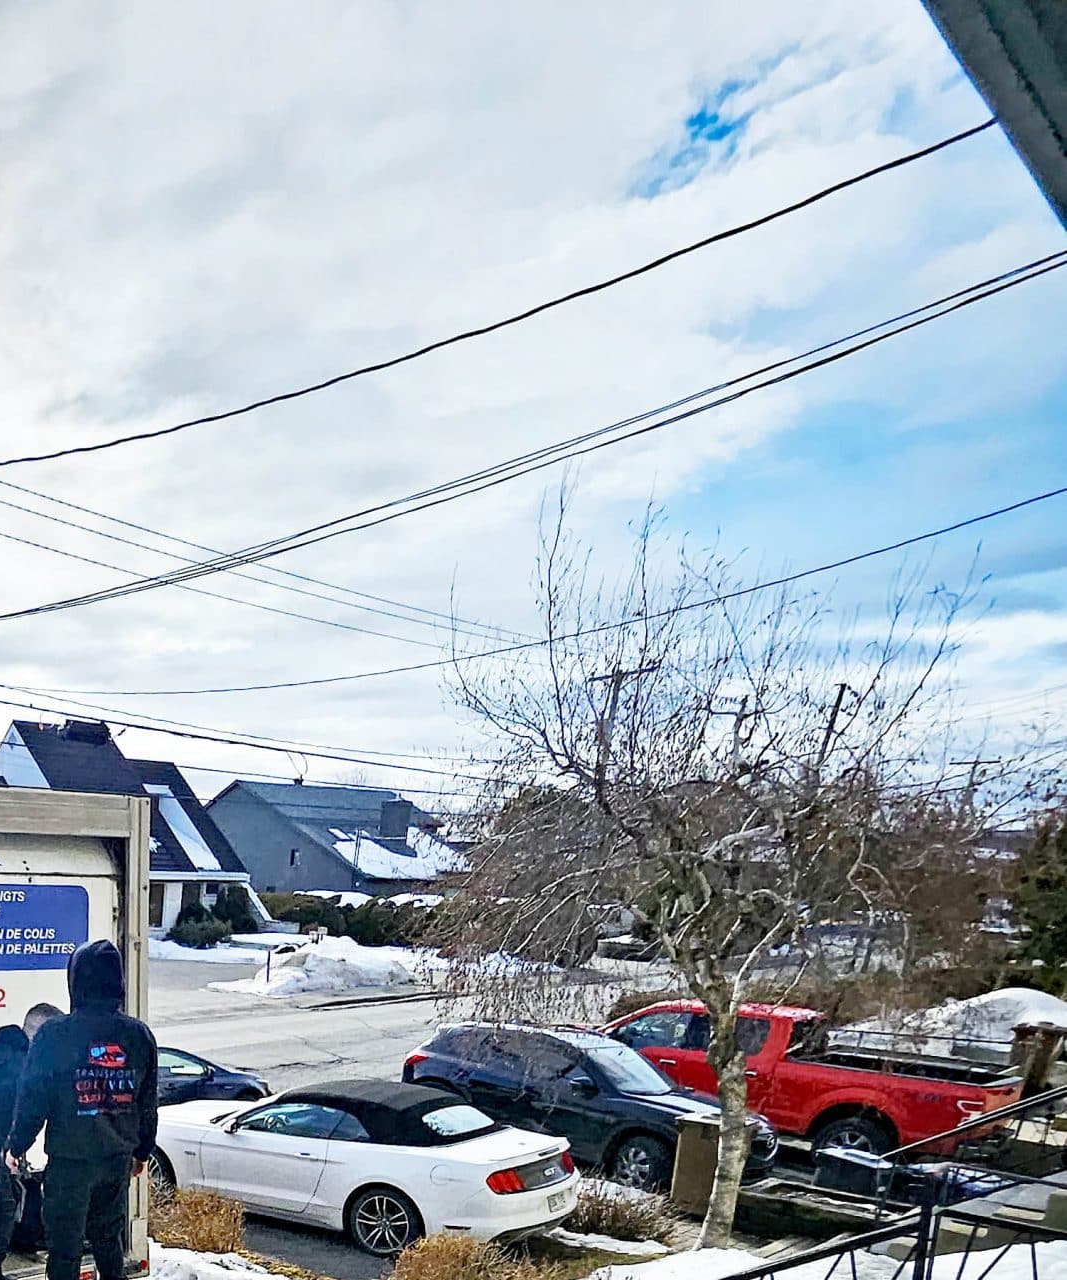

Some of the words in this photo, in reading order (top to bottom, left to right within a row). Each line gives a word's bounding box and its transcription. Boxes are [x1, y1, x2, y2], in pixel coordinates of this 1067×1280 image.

[6, 928, 21, 940] DE
[23, 928, 56, 940] COLIS
[6, 943, 22, 956] DE
[23, 942, 76, 956] PALETTES
